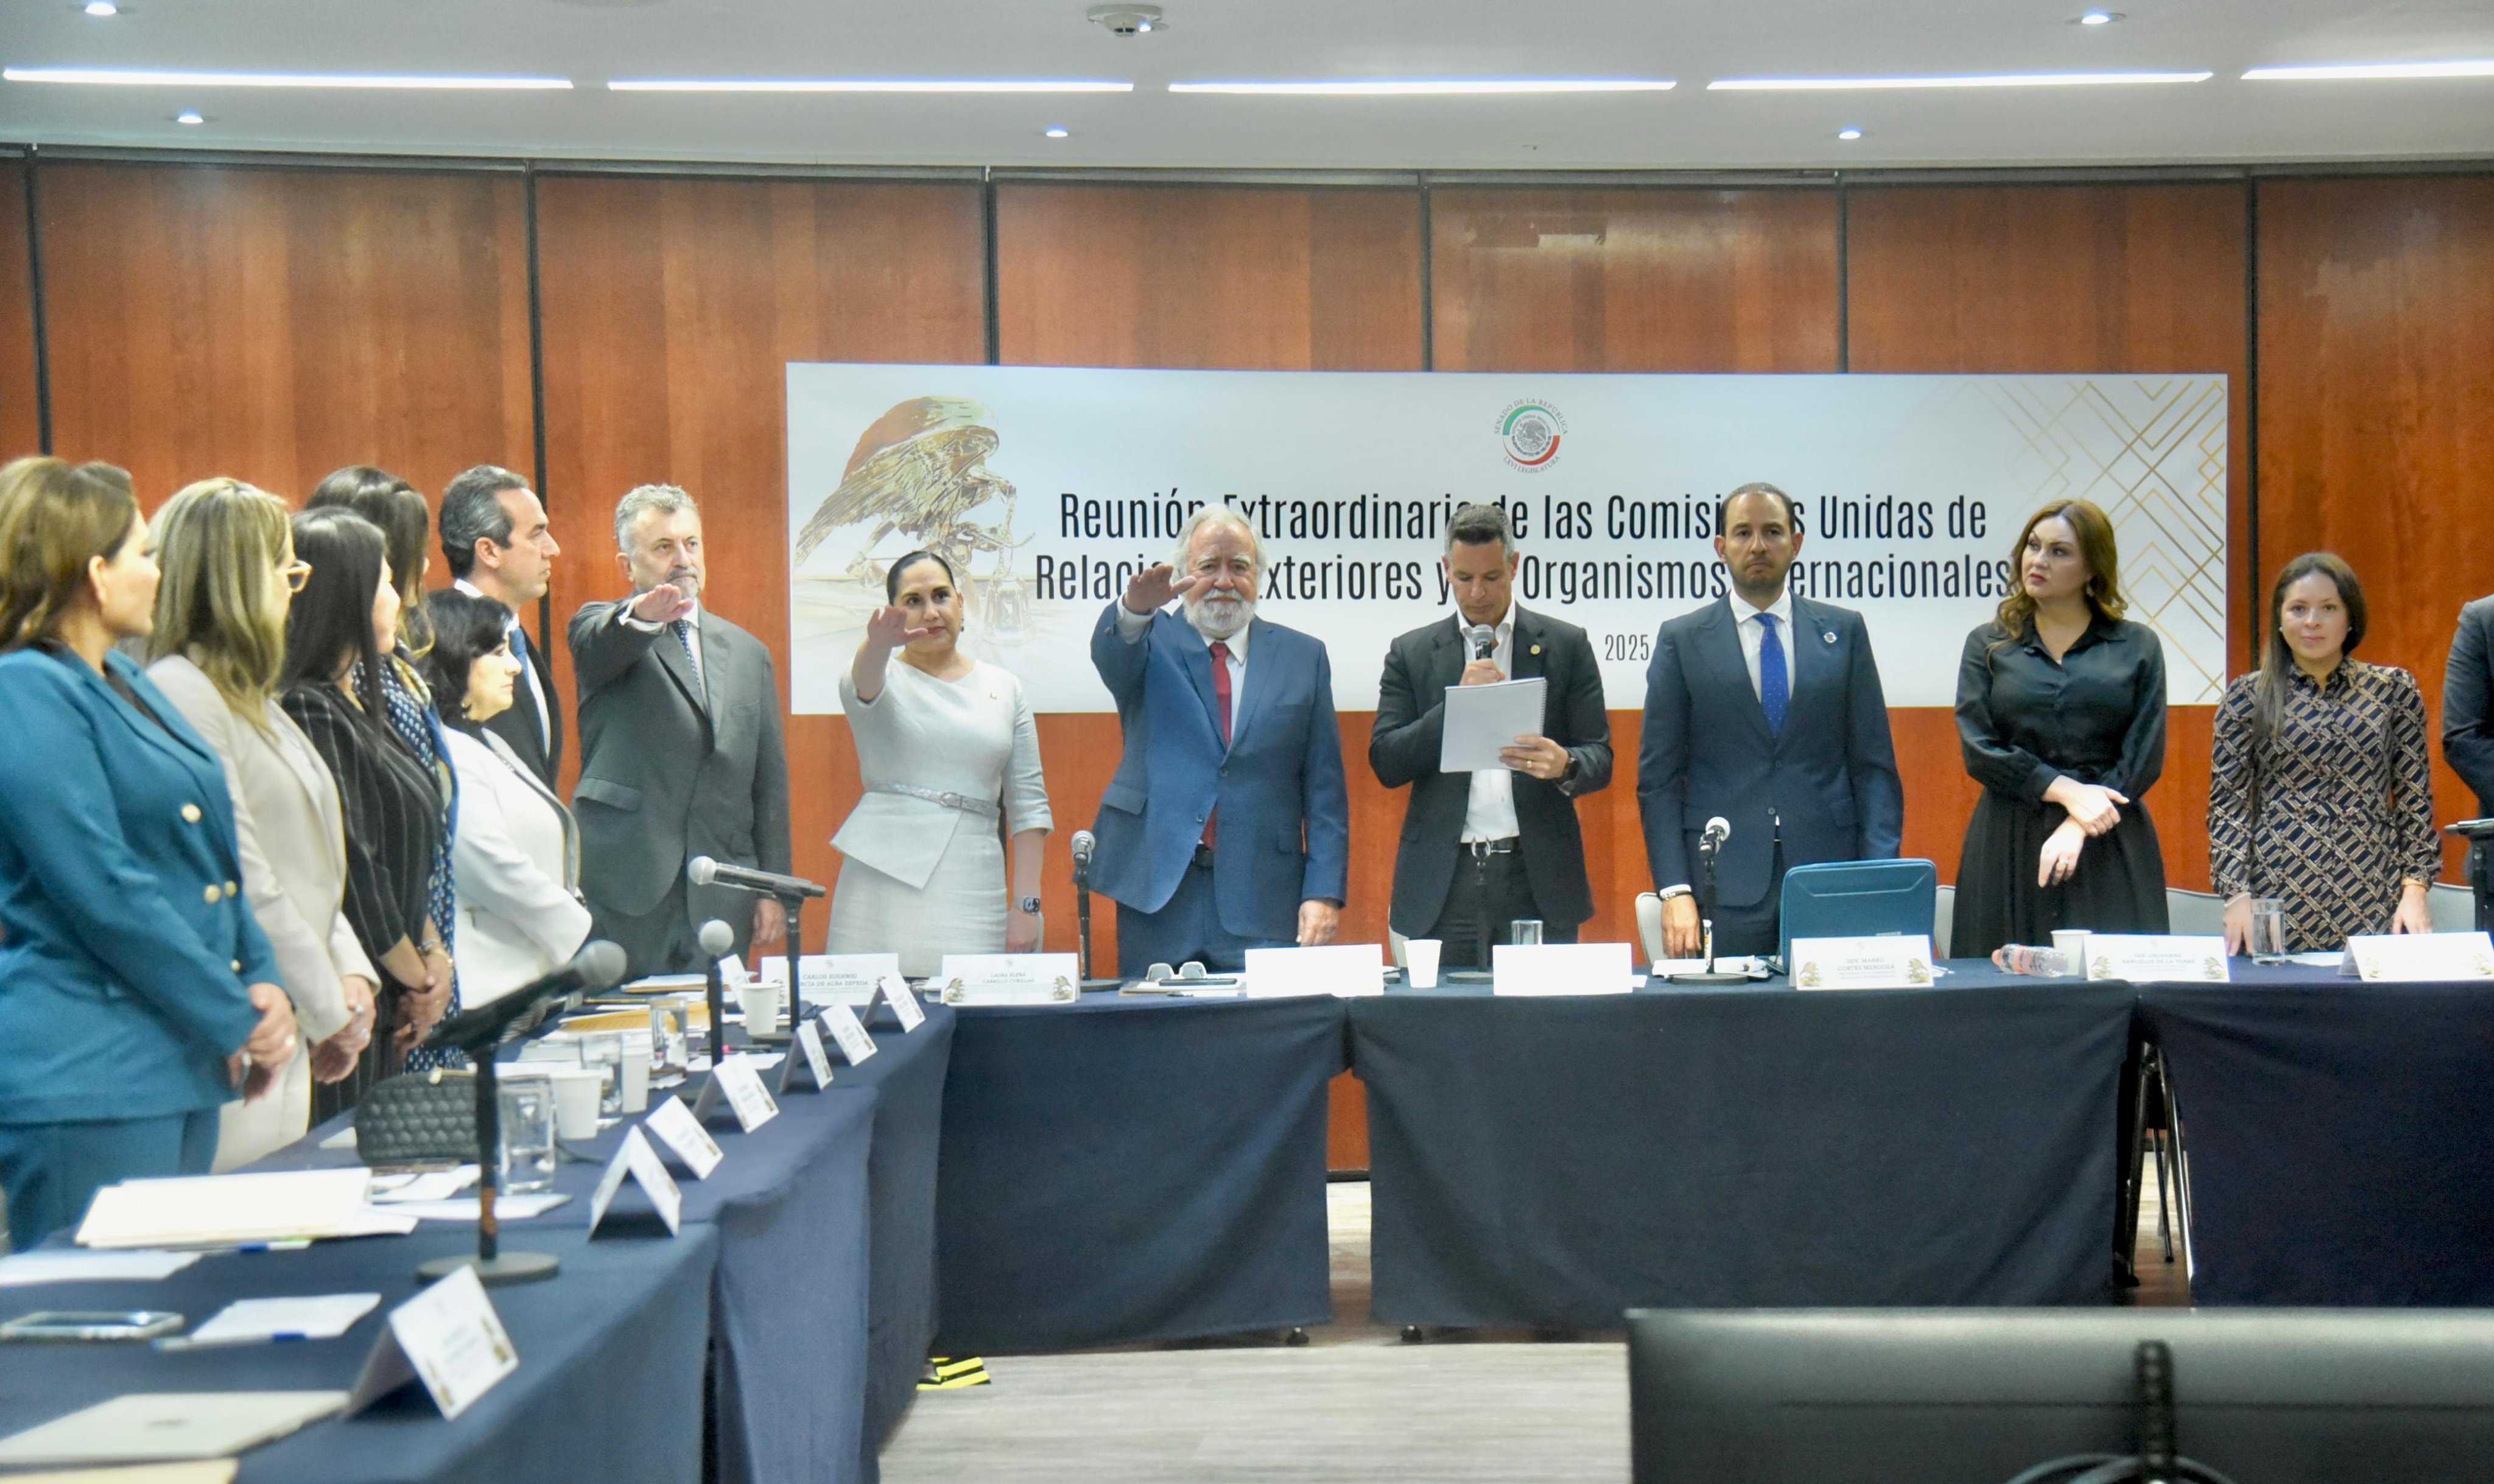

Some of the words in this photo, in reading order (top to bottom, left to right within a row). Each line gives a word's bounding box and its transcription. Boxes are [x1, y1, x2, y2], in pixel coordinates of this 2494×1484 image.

[1494, 404, 1513, 434] SENADO
[1514, 399, 1525, 407] DE
[1518, 456, 1560, 474] LEGISLATURA
[1491, 494, 1528, 539] e
[1544, 494, 1593, 539] las
[1607, 494, 1805, 539] Comisis
[1821, 494, 1934, 539] Unidas
[1948, 494, 1987, 539] de
[1259, 554, 1422, 600] xteriores
[1523, 554, 1726, 605] Organismos
[1790, 553, 2011, 598] ernacionales
[1604, 634, 1649, 661] 2025
